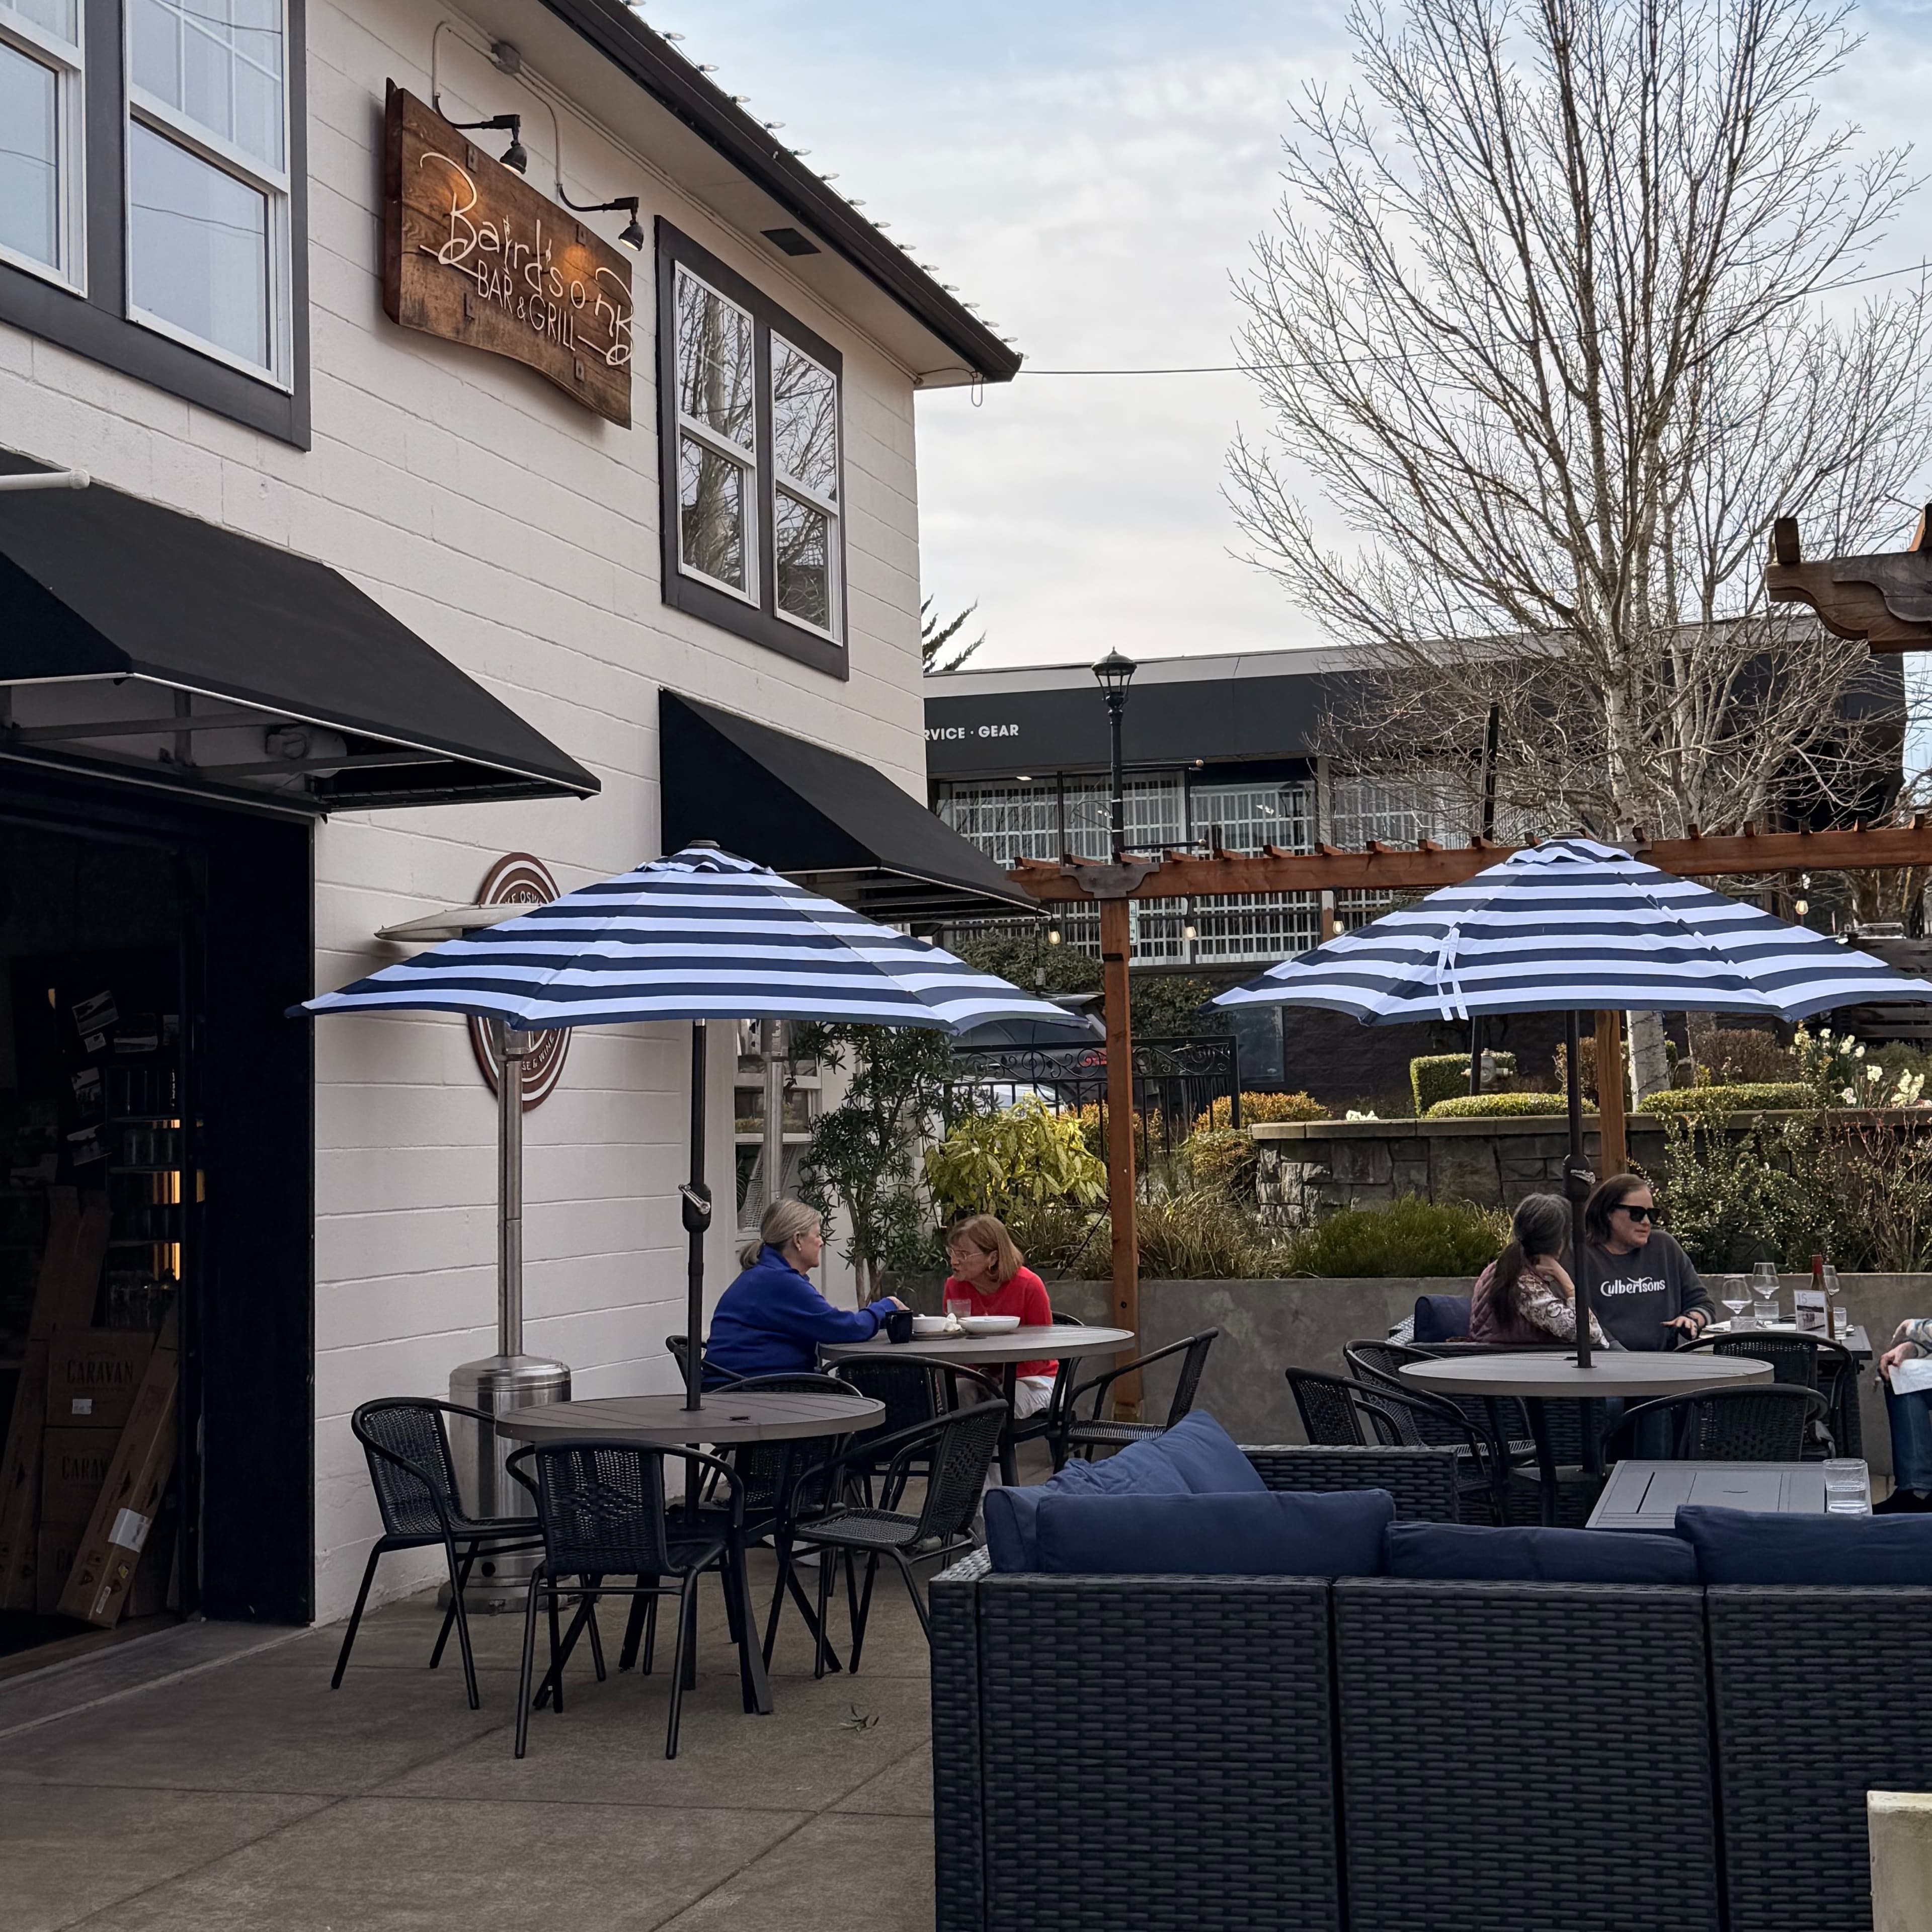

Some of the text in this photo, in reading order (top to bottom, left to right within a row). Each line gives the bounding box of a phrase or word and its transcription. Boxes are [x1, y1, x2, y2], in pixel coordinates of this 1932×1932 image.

[477, 259, 576, 351] BAR & GRILL
[571, 280, 614, 337] on
[577, 267, 635, 365] B
[978, 724, 1019, 738] GEAR
[1600, 1276, 1666, 1297] Culbertsons
[67, 1359, 133, 1384] CARAVAN
